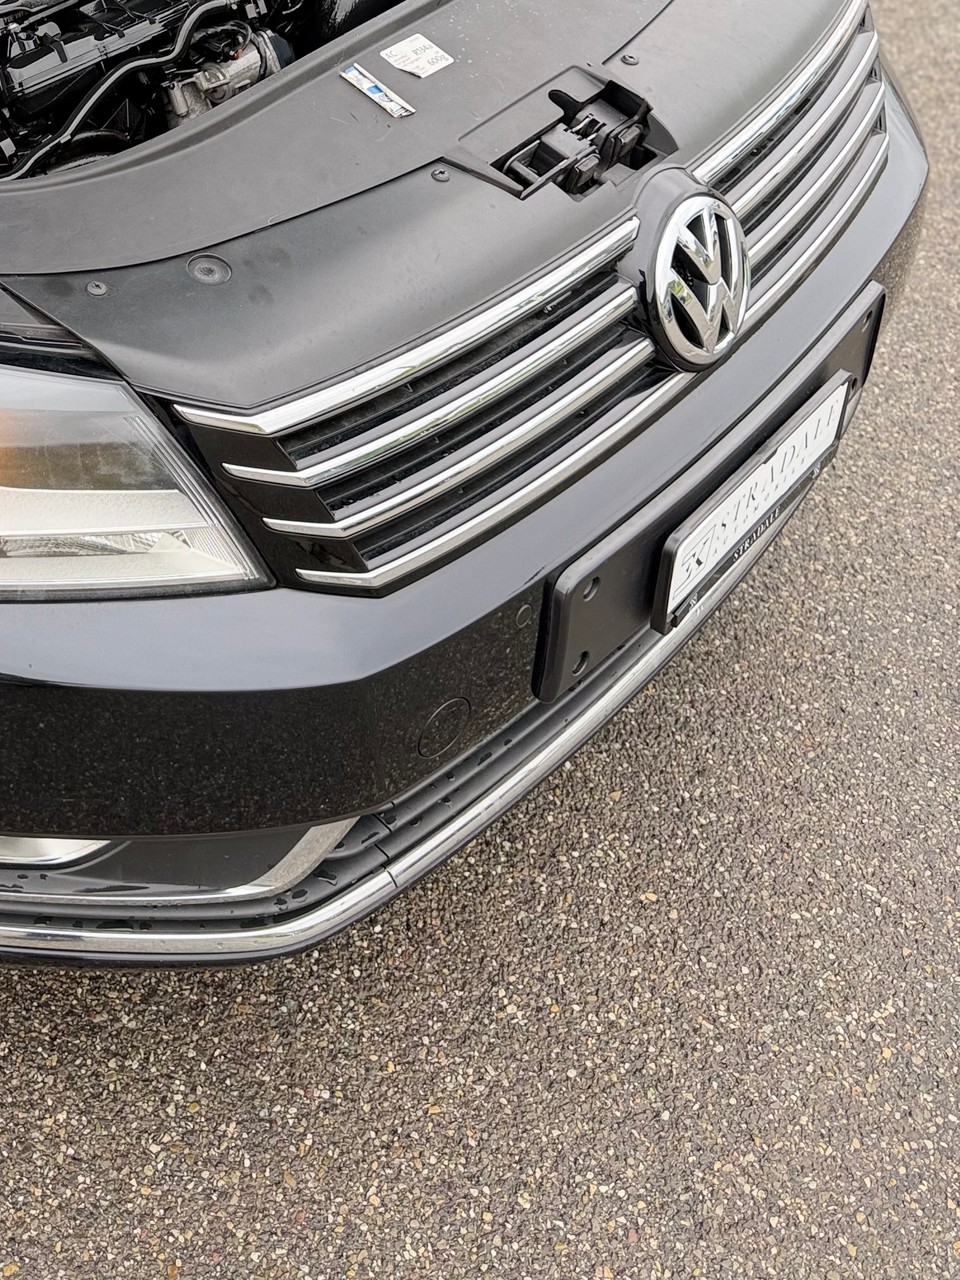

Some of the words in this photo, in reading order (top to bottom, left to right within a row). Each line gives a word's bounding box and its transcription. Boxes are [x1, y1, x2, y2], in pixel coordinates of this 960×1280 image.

[385, 50, 398, 60] AC
[716, 398, 839, 542] STRADALE
[732, 504, 782, 562] STRADALE
